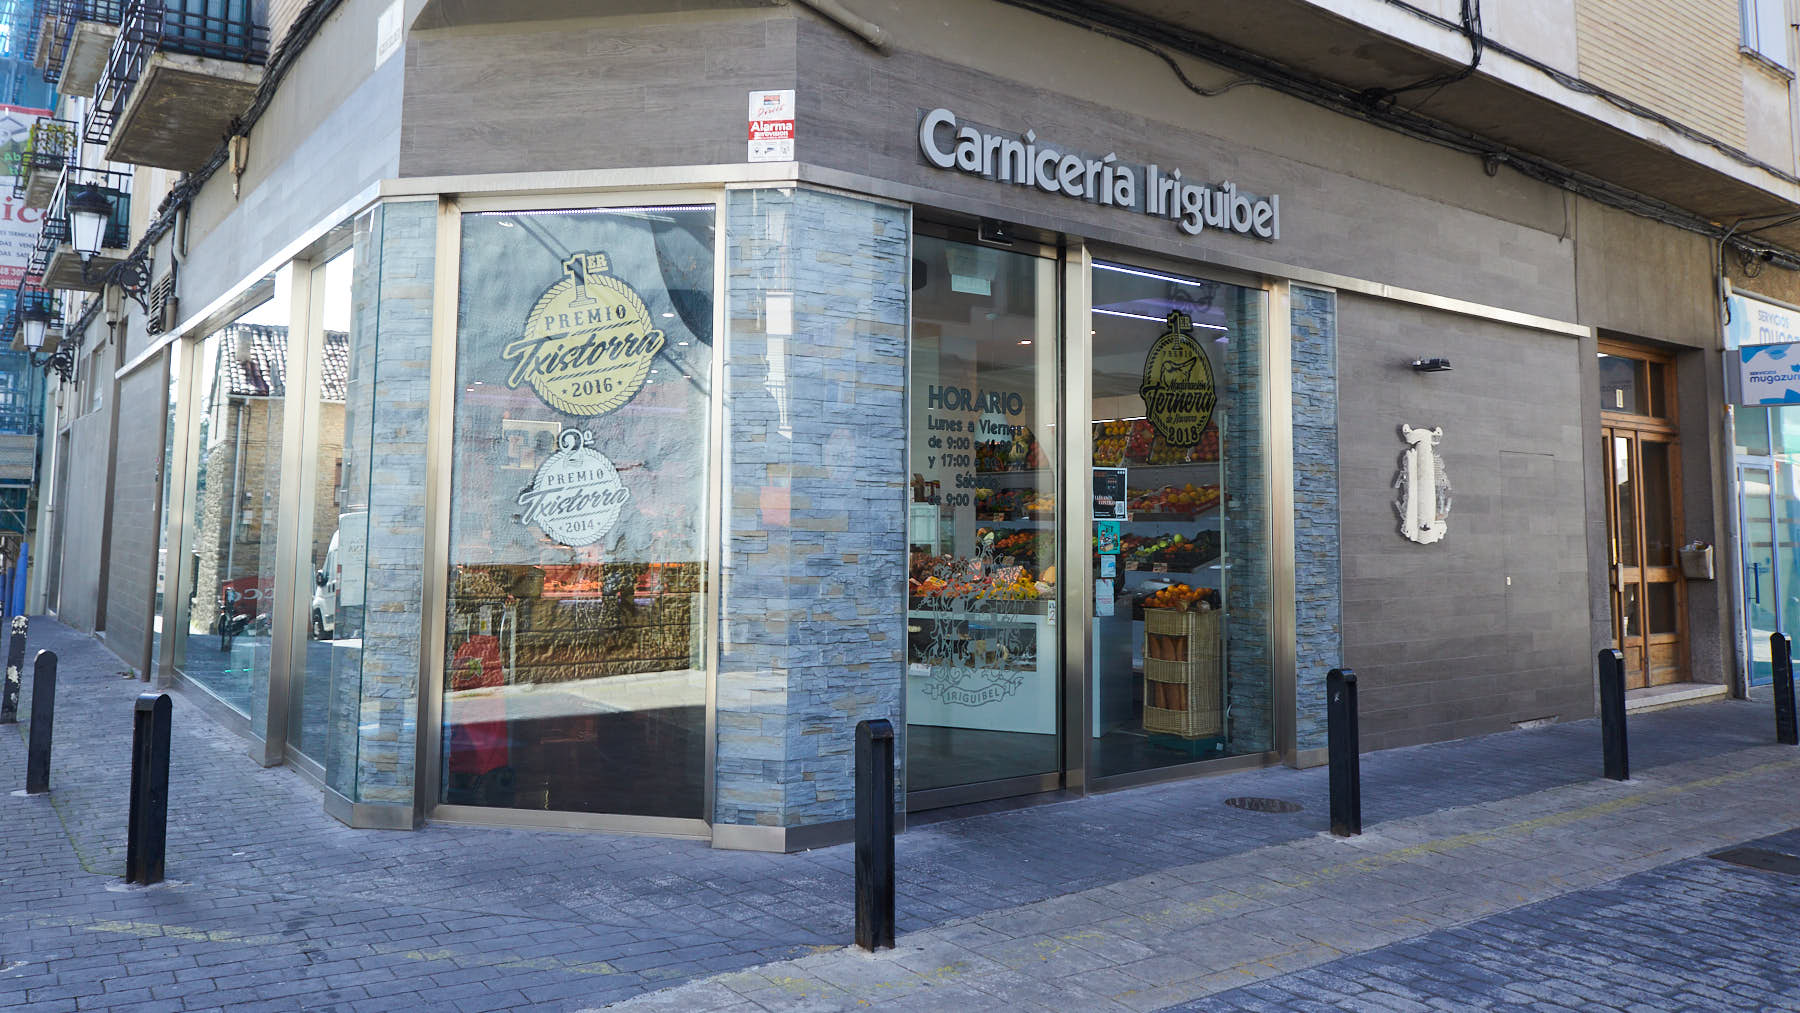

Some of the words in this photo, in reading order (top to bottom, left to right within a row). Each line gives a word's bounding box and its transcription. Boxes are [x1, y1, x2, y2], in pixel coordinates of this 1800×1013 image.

[751, 121, 792, 131] Alarma
[919, 107, 1136, 207] Carnicería
[1146, 164, 1280, 240] Iriguibel
[544, 304, 627, 331] PREMIO
[503, 330, 664, 388] Txistorra
[571, 377, 613, 398] 2016
[928, 384, 1023, 416] HORARIO
[1142, 382, 1213, 424] Ternera
[928, 415, 963, 433] Lunes
[967, 422, 975, 432] a
[979, 419, 1023, 437] Viernes
[1168, 425, 1199, 444] 2018
[928, 435, 942, 449] de
[947, 436, 970, 450] 9:00
[928, 455, 936, 469] y
[941, 453, 970, 468] 17:00
[548, 469, 604, 486] PREMIO
[519, 487, 628, 525] Txistorra
[946, 493, 969, 507] 9:00
[565, 520, 594, 532] 2014
[946, 690, 1000, 702] IRIGUIBEL
